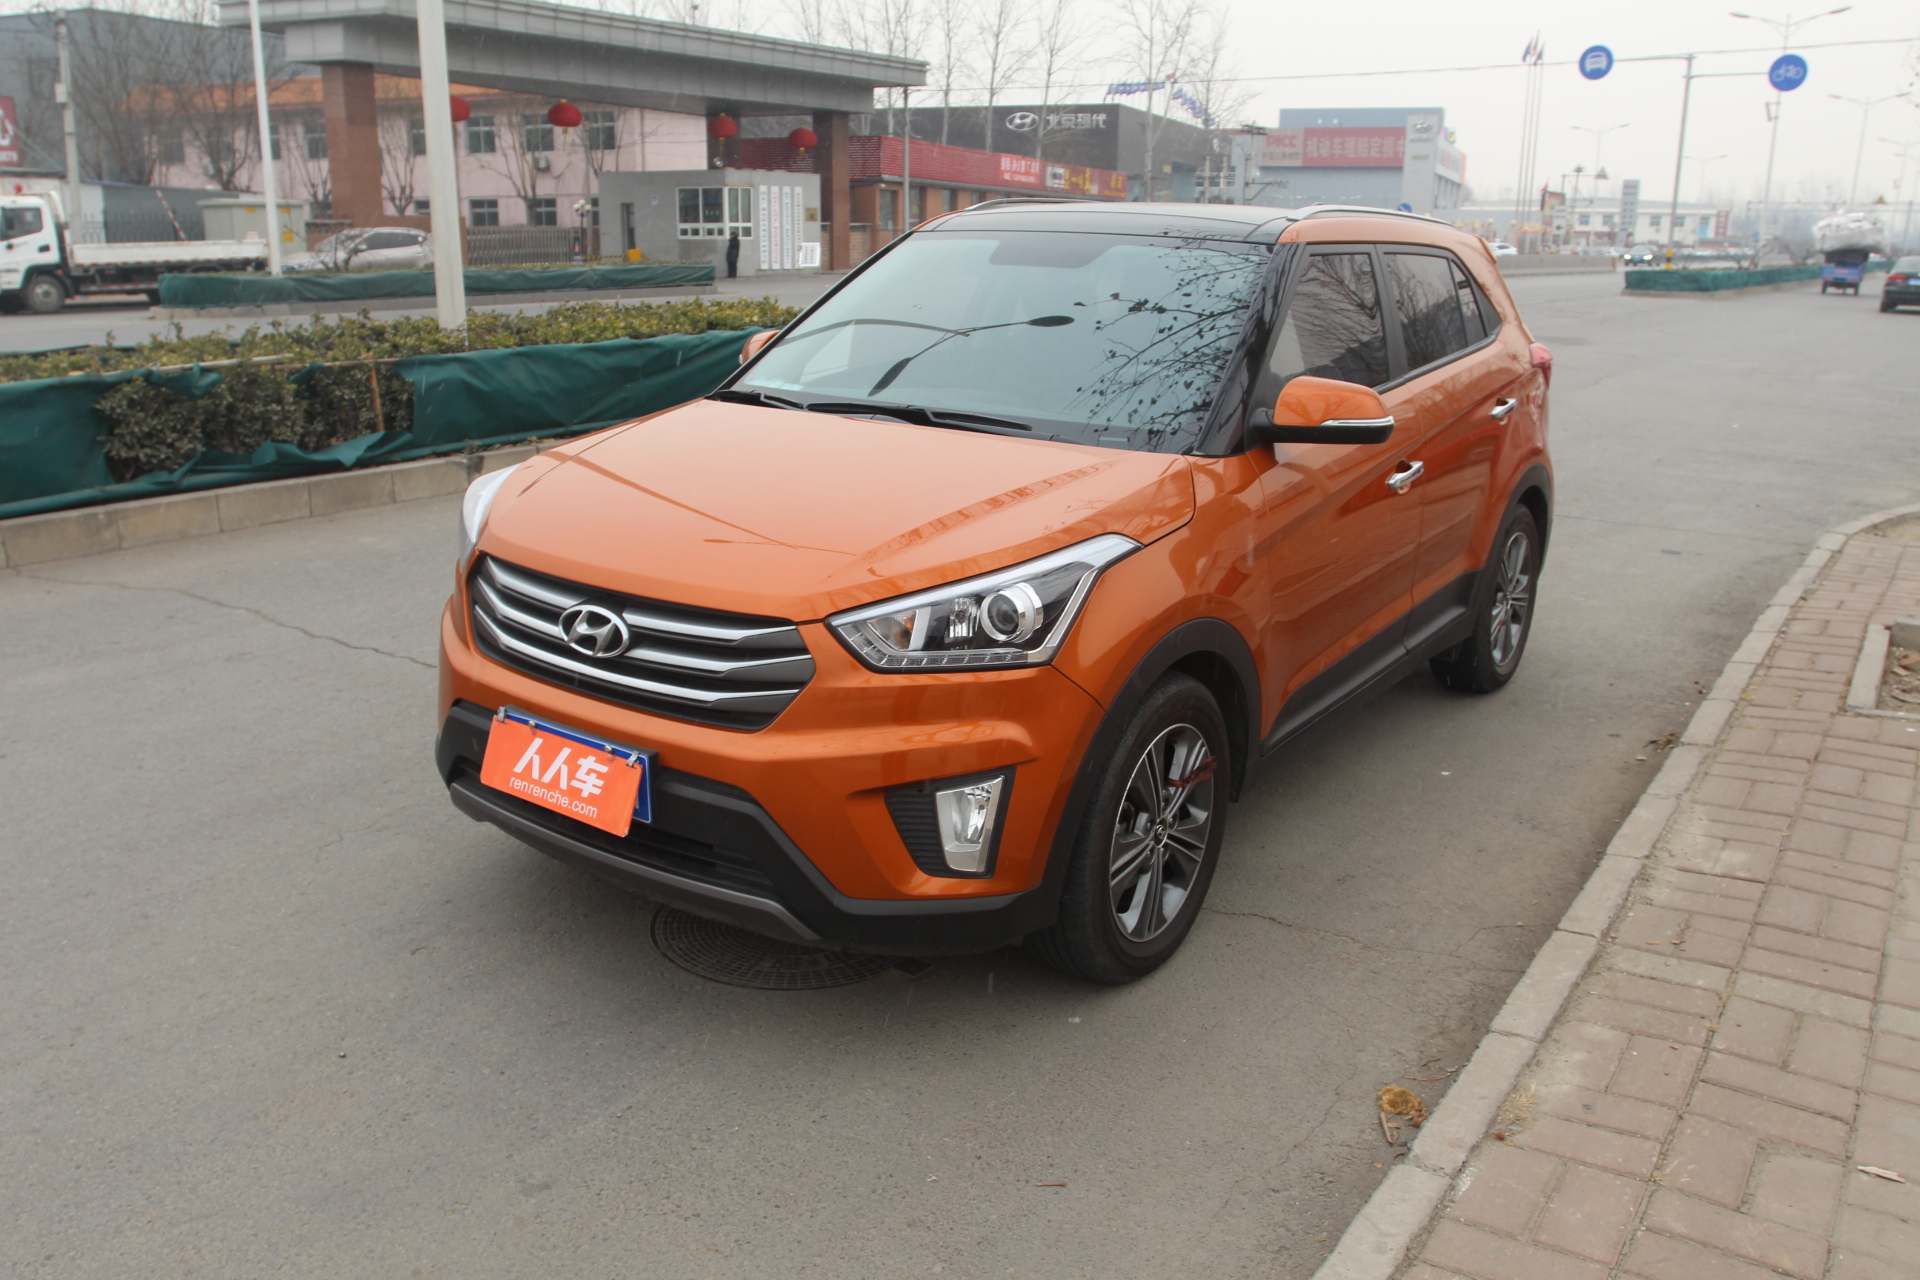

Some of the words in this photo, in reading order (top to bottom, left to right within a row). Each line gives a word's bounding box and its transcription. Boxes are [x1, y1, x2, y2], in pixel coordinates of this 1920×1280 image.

[1046, 113, 1107, 129] 北京现代
[1266, 134, 1297, 148] PICC
[513, 737, 609, 798] 人人车
[509, 776, 598, 819] renrenche.com
